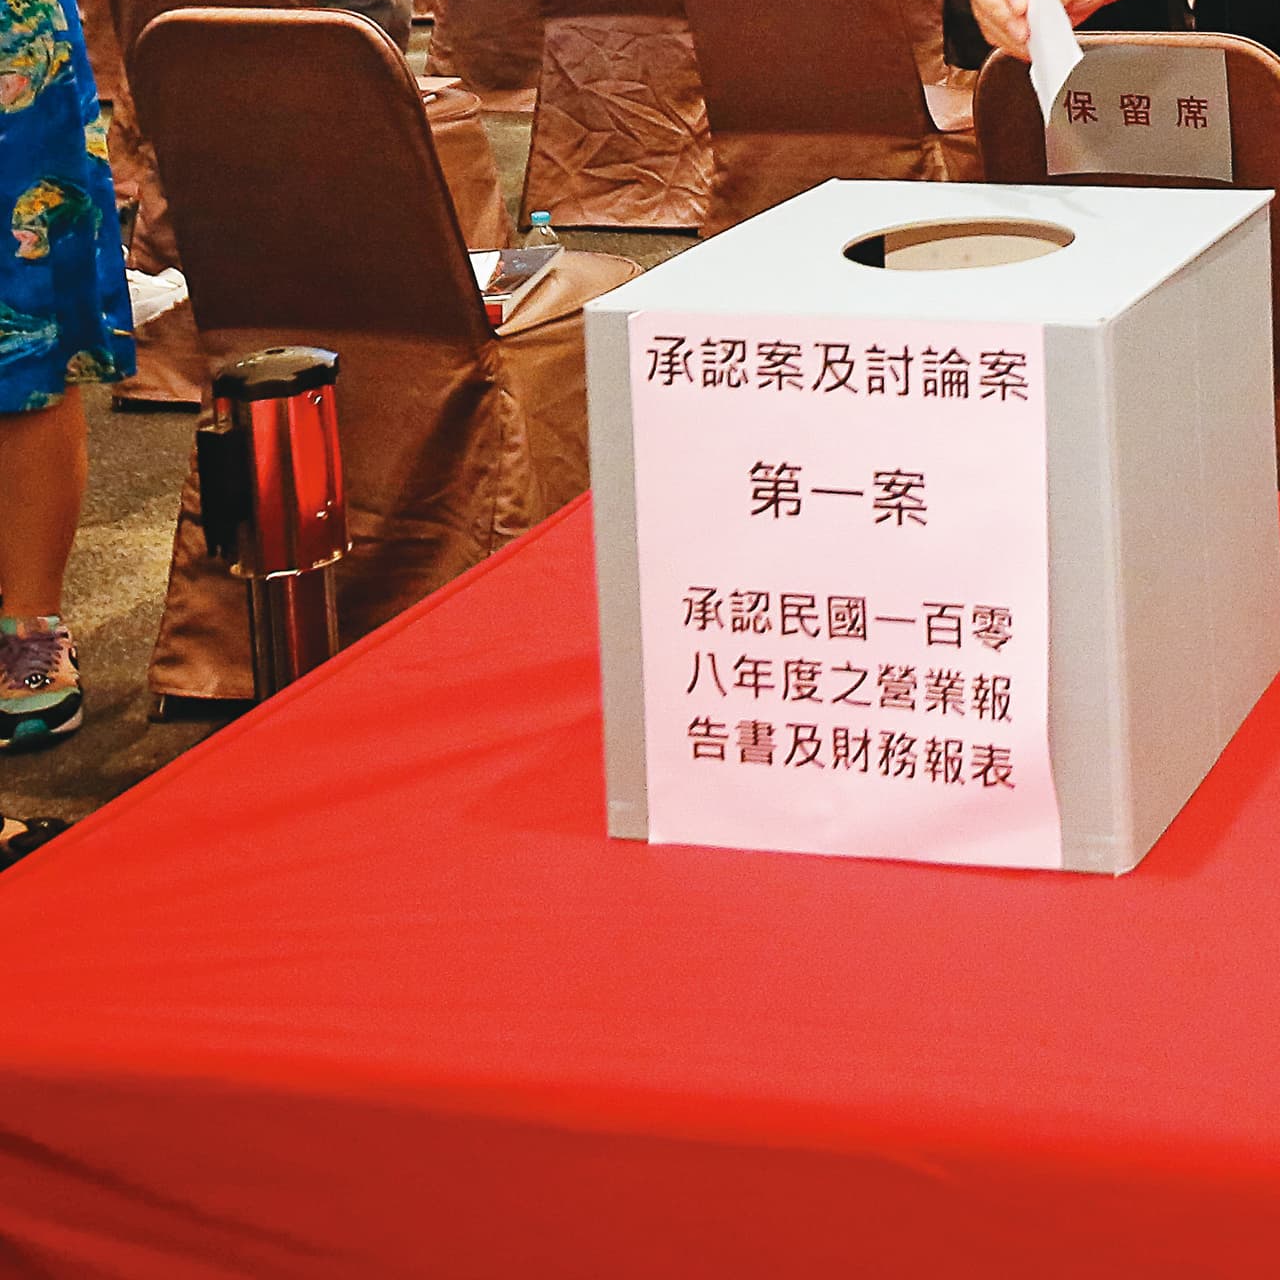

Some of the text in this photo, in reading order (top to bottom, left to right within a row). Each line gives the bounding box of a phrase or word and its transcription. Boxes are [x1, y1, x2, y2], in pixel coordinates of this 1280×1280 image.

[1063, 89, 1210, 129] 保留席
[646, 335, 1029, 402] 承認案及討論案
[748, 460, 929, 526] 第一案
[682, 585, 1013, 653] 承認民國一百零
[686, 651, 1012, 724] 八年度之營業報
[687, 715, 1017, 790] 告書及財務報表
